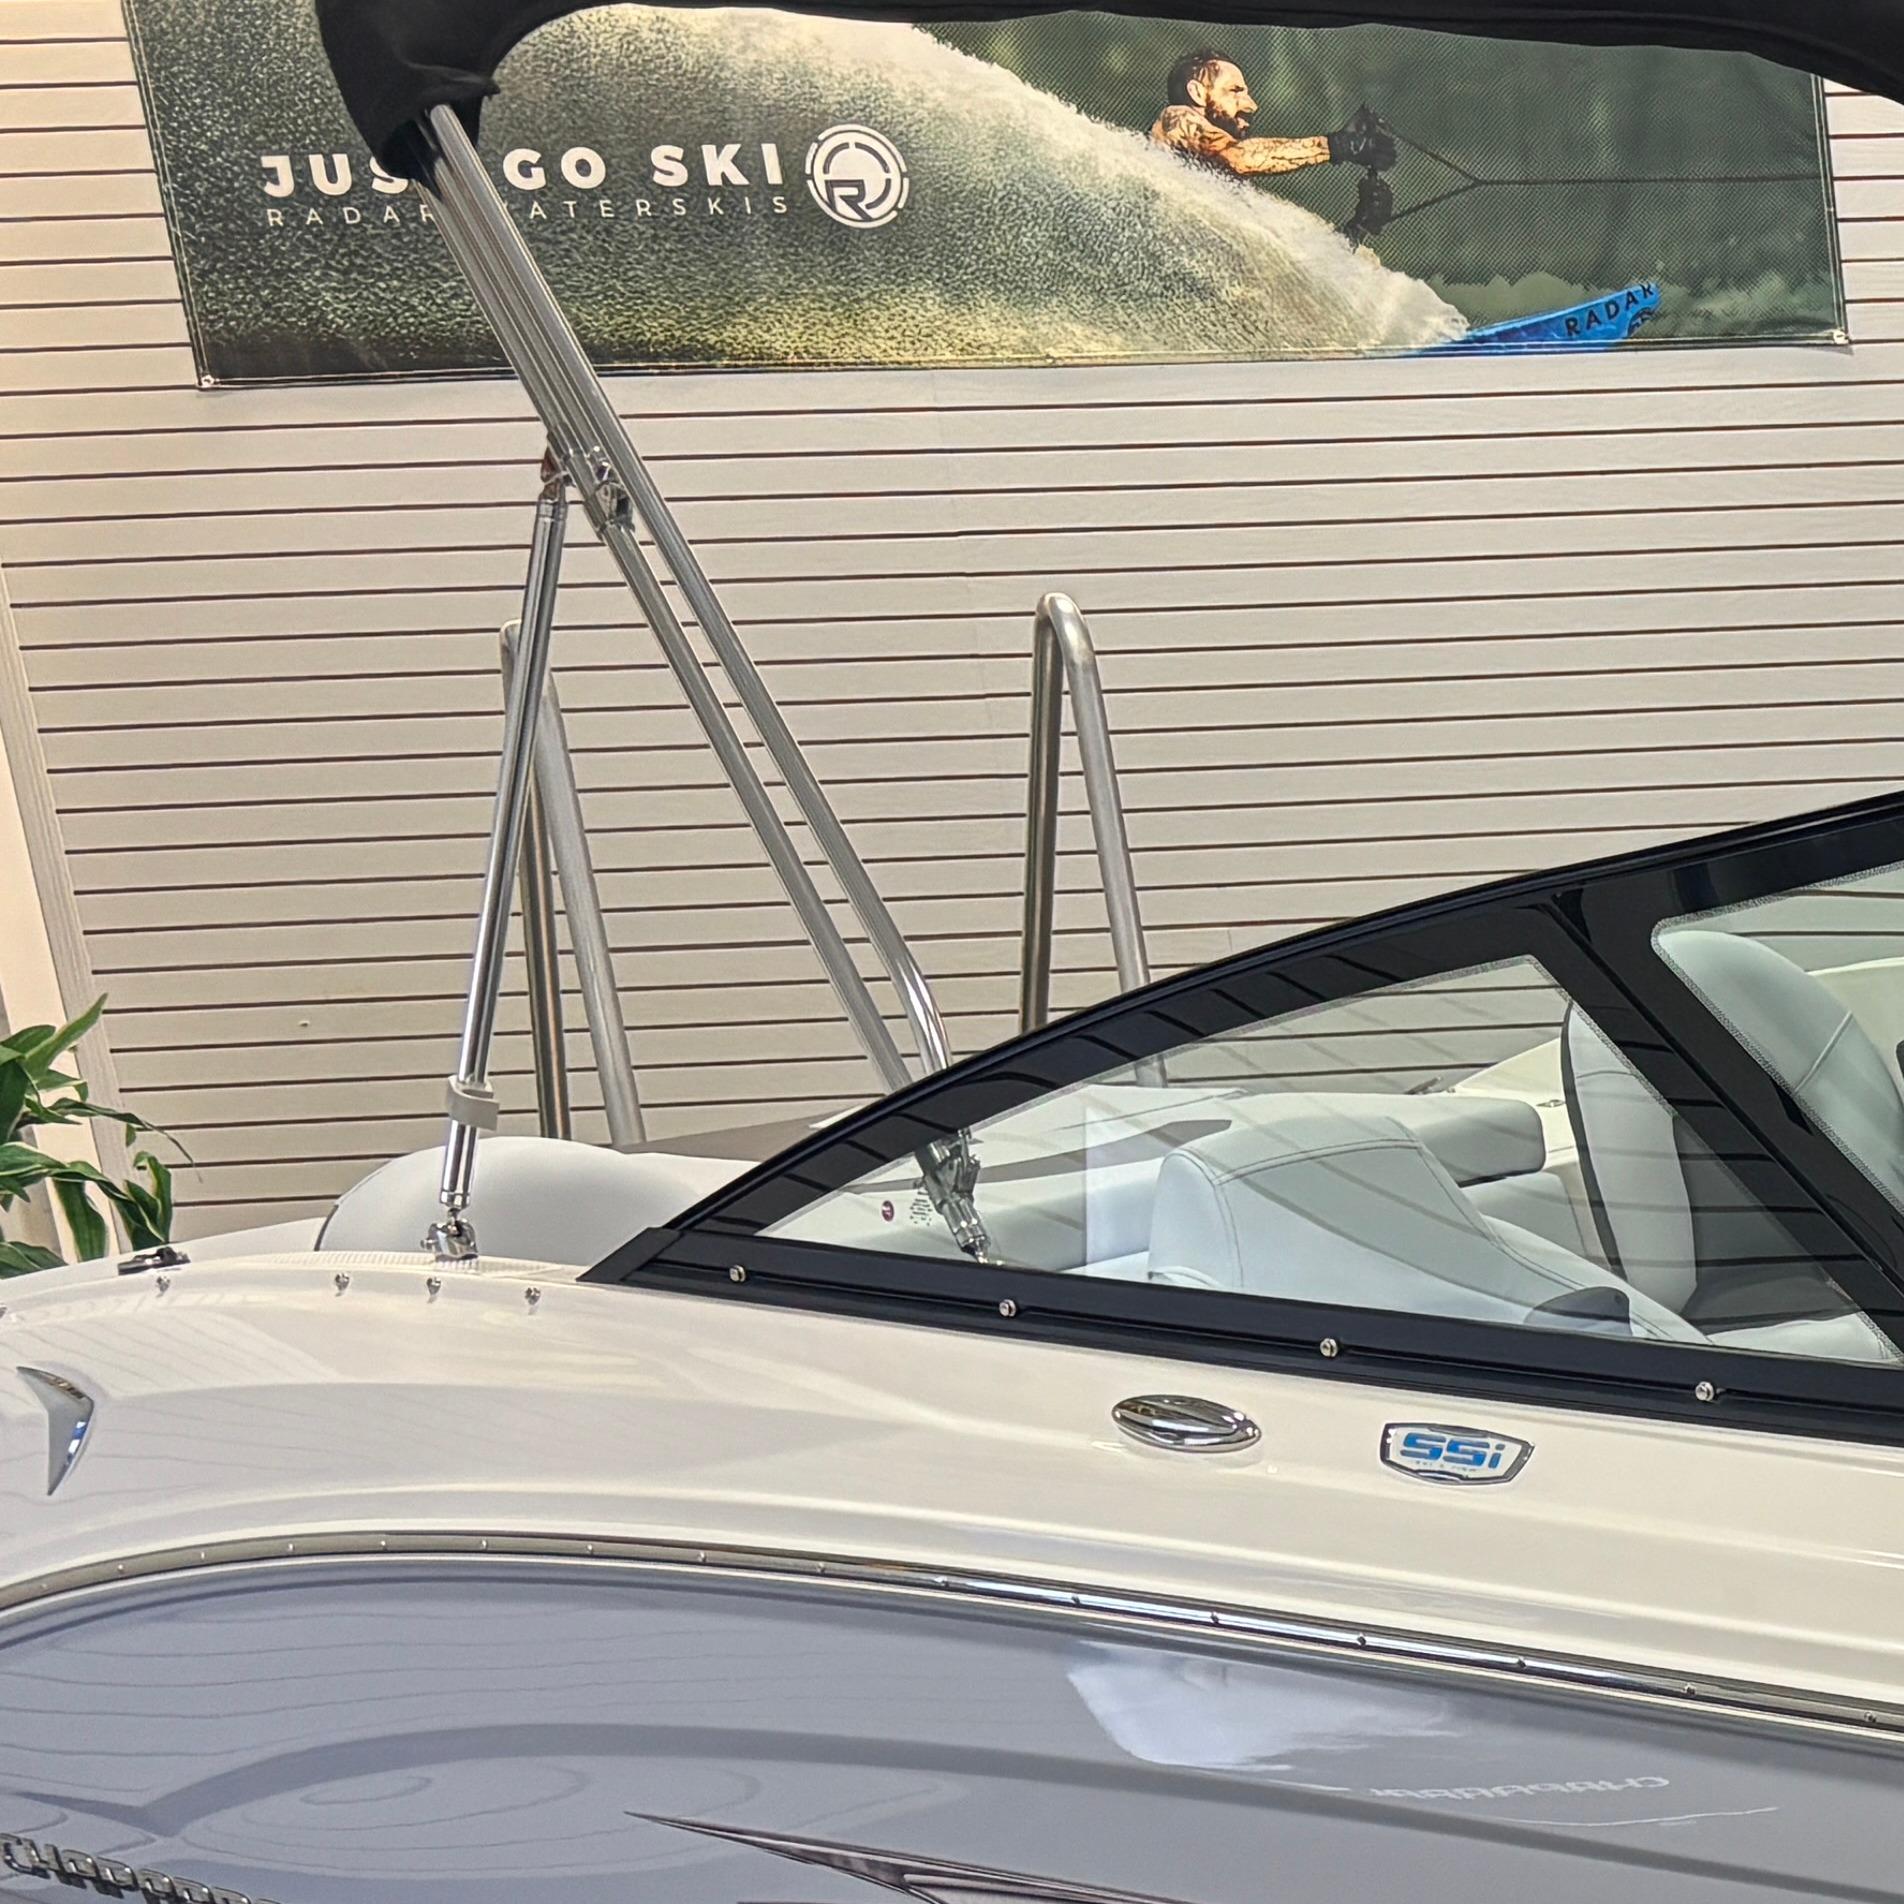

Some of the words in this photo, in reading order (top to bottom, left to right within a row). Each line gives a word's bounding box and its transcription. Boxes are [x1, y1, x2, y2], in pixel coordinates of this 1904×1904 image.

[261, 153, 409, 198] JUS
[503, 146, 606, 191] GO
[652, 142, 784, 187] SKI
[267, 203, 435, 227] RADAR
[499, 195, 790, 221] ATERSKIS
[1400, 1432, 1506, 1469] SSi
